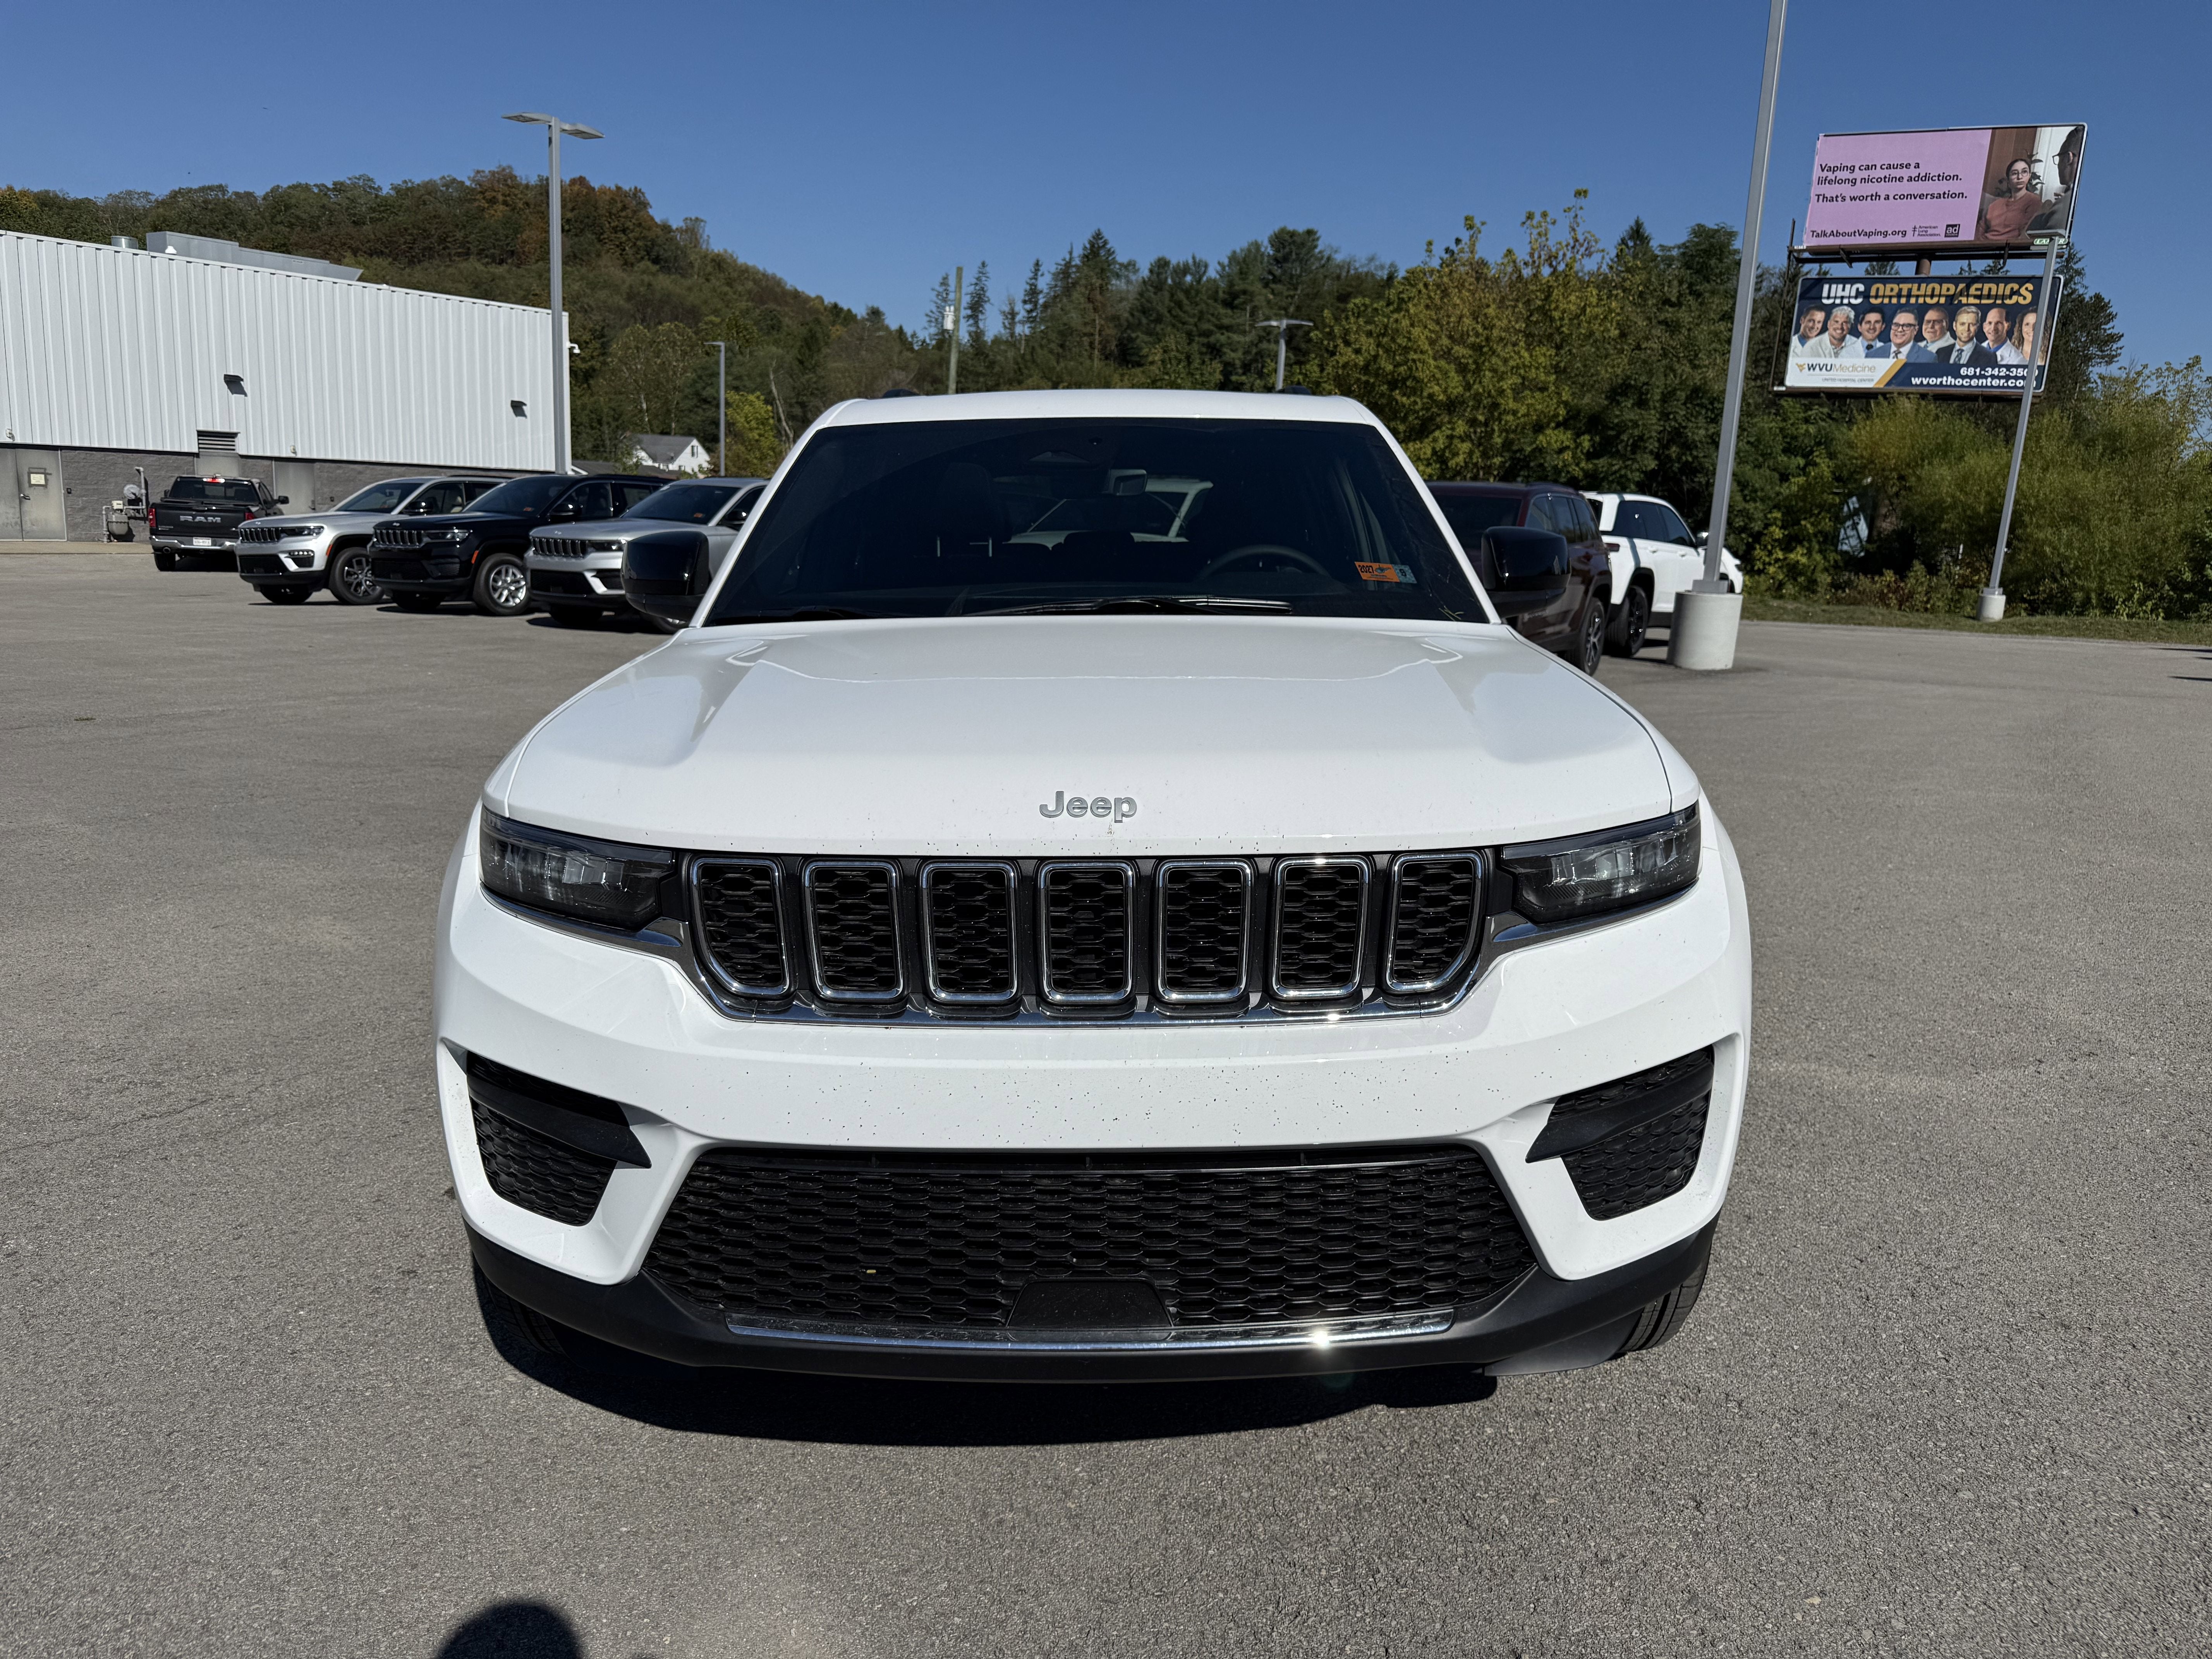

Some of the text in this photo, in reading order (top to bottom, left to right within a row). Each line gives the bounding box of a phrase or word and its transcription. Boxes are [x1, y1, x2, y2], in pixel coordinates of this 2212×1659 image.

[1820, 163, 1855, 174] Vaping
[1880, 161, 1911, 170] cause
[1817, 172, 1962, 186] lifelong nicotine addiction.
[1815, 193, 1846, 203] That's
[1850, 192, 1881, 201] worth
[1893, 190, 1967, 200] conversation.
[1810, 228, 1906, 239] TalkAboutVaping.org
[1946, 224, 1959, 234] ad
[1821, 283, 2033, 304] UHC ORTHOPAEDICS
[1358, 565, 1374, 574] 2027
[1039, 790, 1137, 823] Jeep
